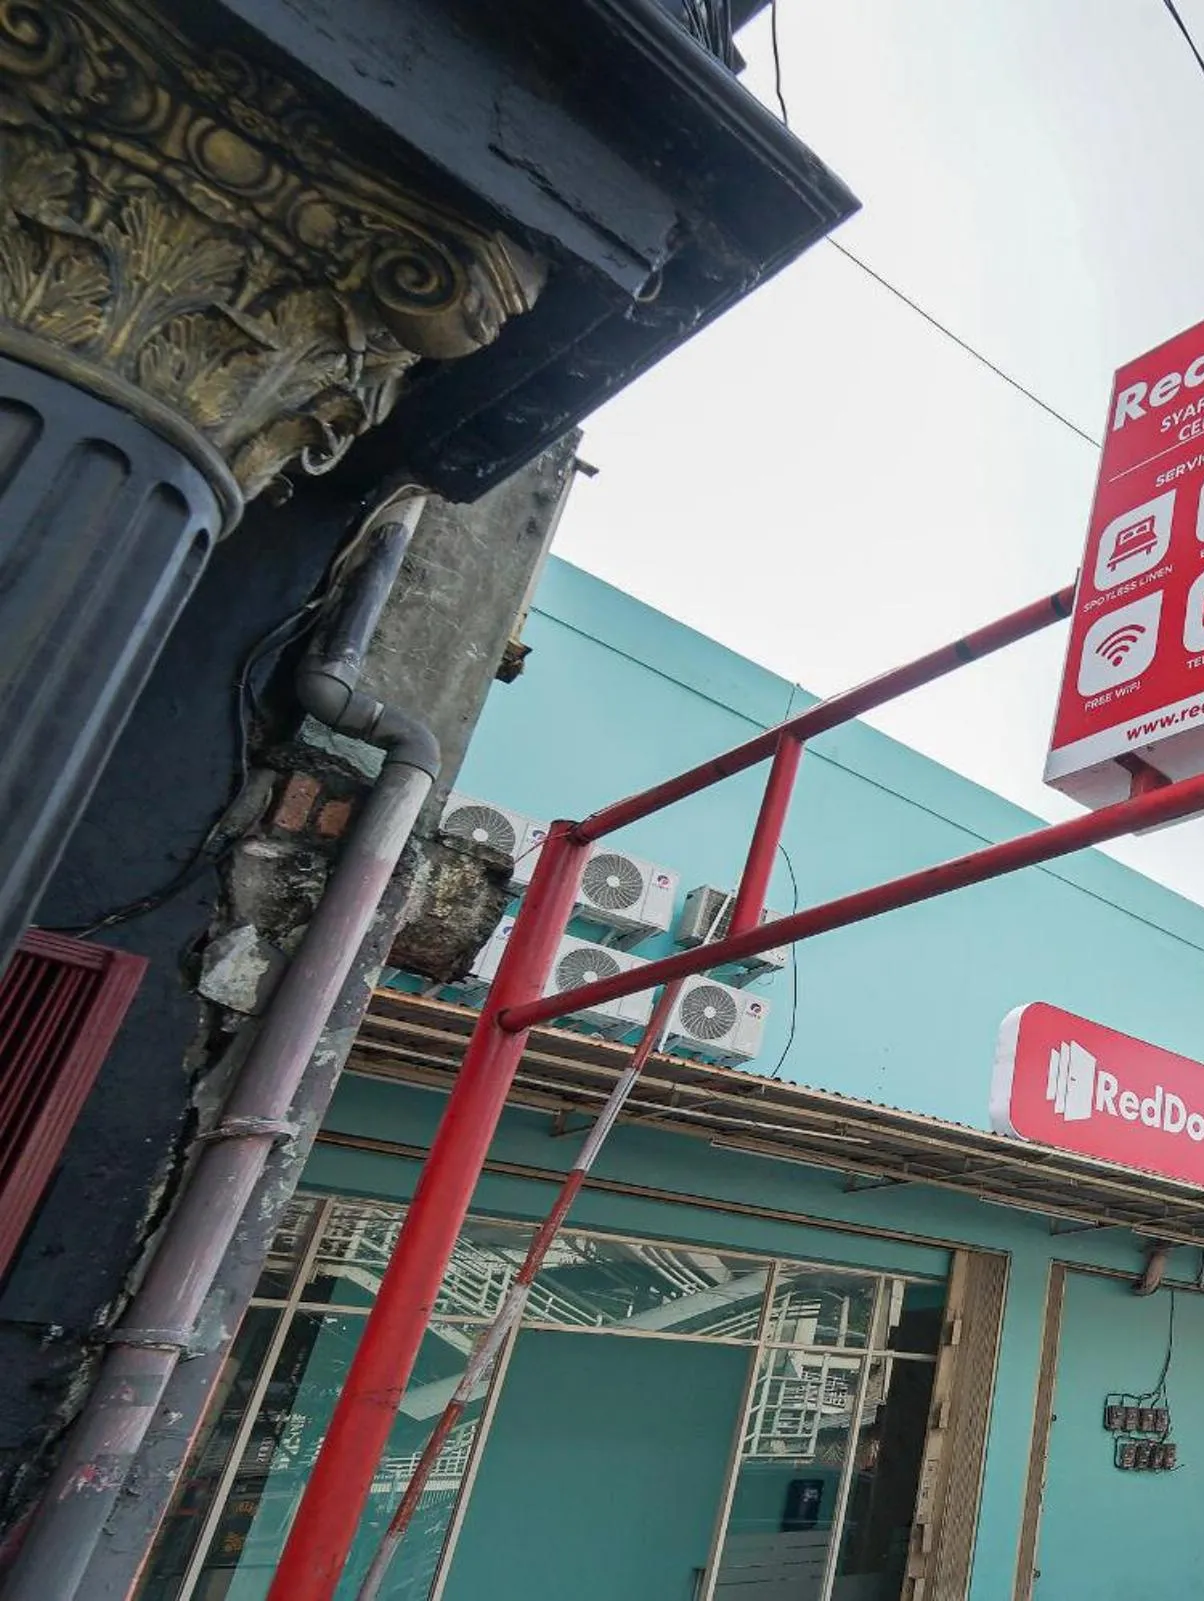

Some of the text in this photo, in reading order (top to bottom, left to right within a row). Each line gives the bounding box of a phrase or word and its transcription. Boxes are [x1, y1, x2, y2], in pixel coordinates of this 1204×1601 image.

[1083, 564, 1173, 613] SPOTLESS LINEN
[1084, 692, 1112, 712] FREE
